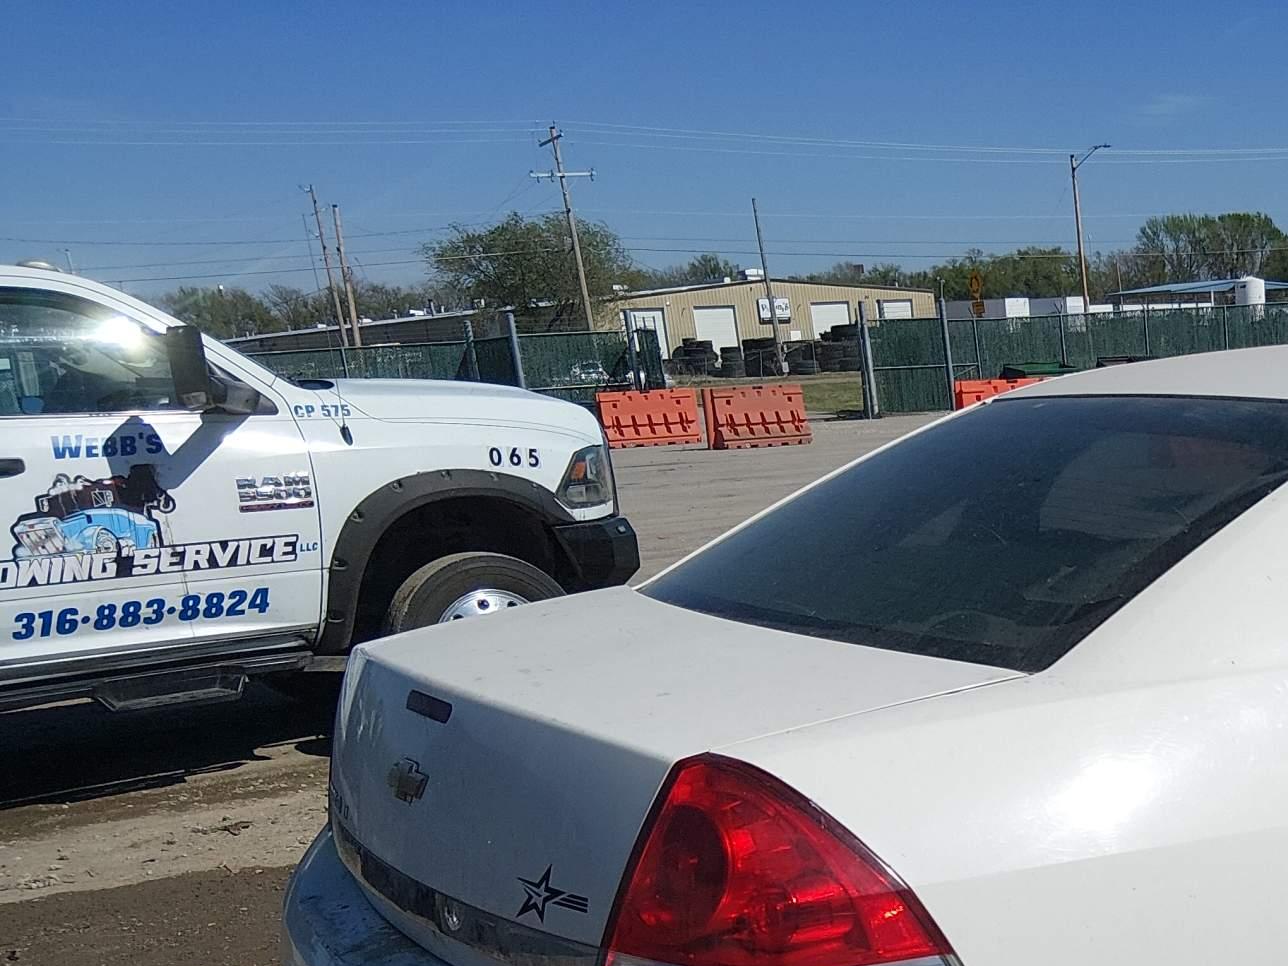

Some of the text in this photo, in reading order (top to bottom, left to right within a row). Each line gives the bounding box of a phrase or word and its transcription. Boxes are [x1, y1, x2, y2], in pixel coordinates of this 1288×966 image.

[293, 404, 351, 418] CP 575
[133, 537, 298, 575] SERVICE
[300, 542, 318, 553] LLC
